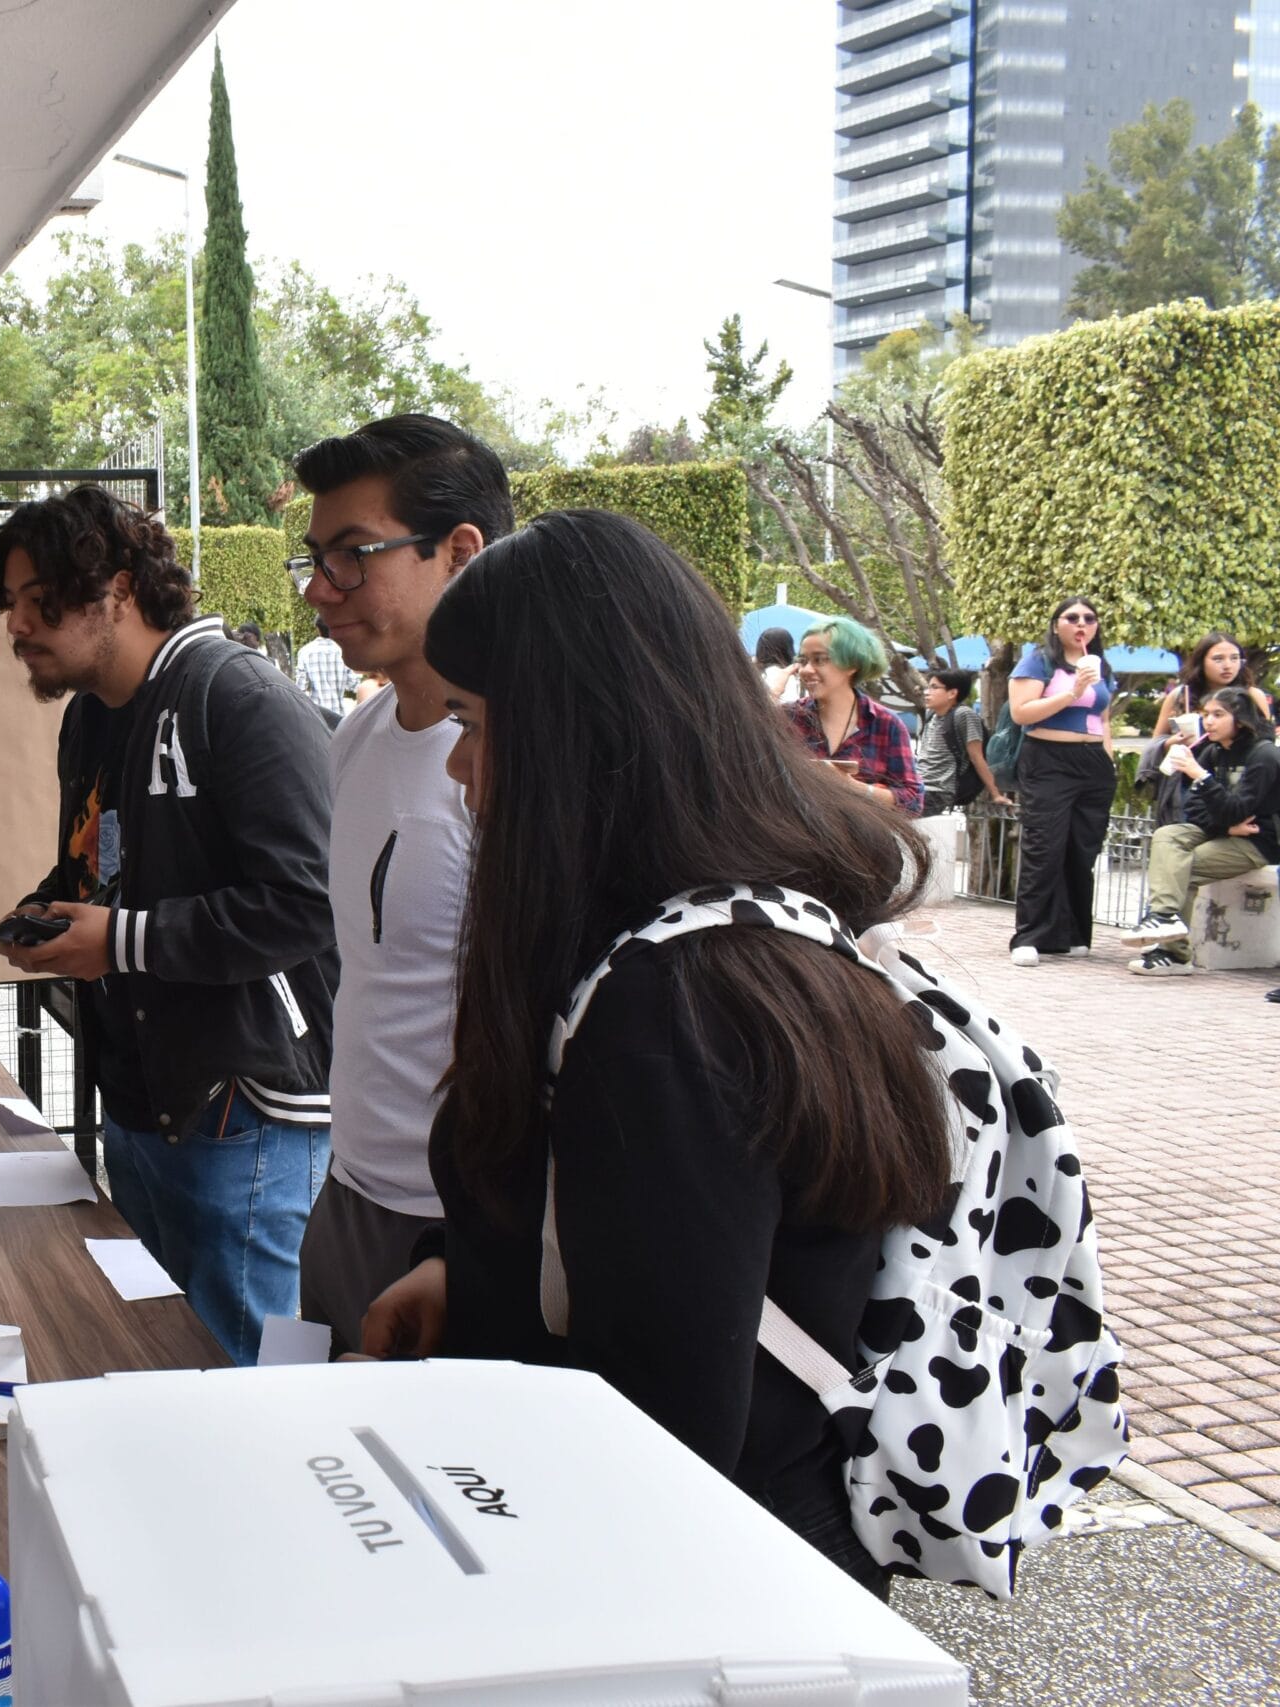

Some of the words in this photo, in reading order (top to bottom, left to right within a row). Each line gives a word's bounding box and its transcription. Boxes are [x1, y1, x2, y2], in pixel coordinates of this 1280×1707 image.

[306, 1455, 376, 1517] VOTO
[426, 1465, 519, 1519] AQUÍ
[349, 1520, 404, 1554] TU
